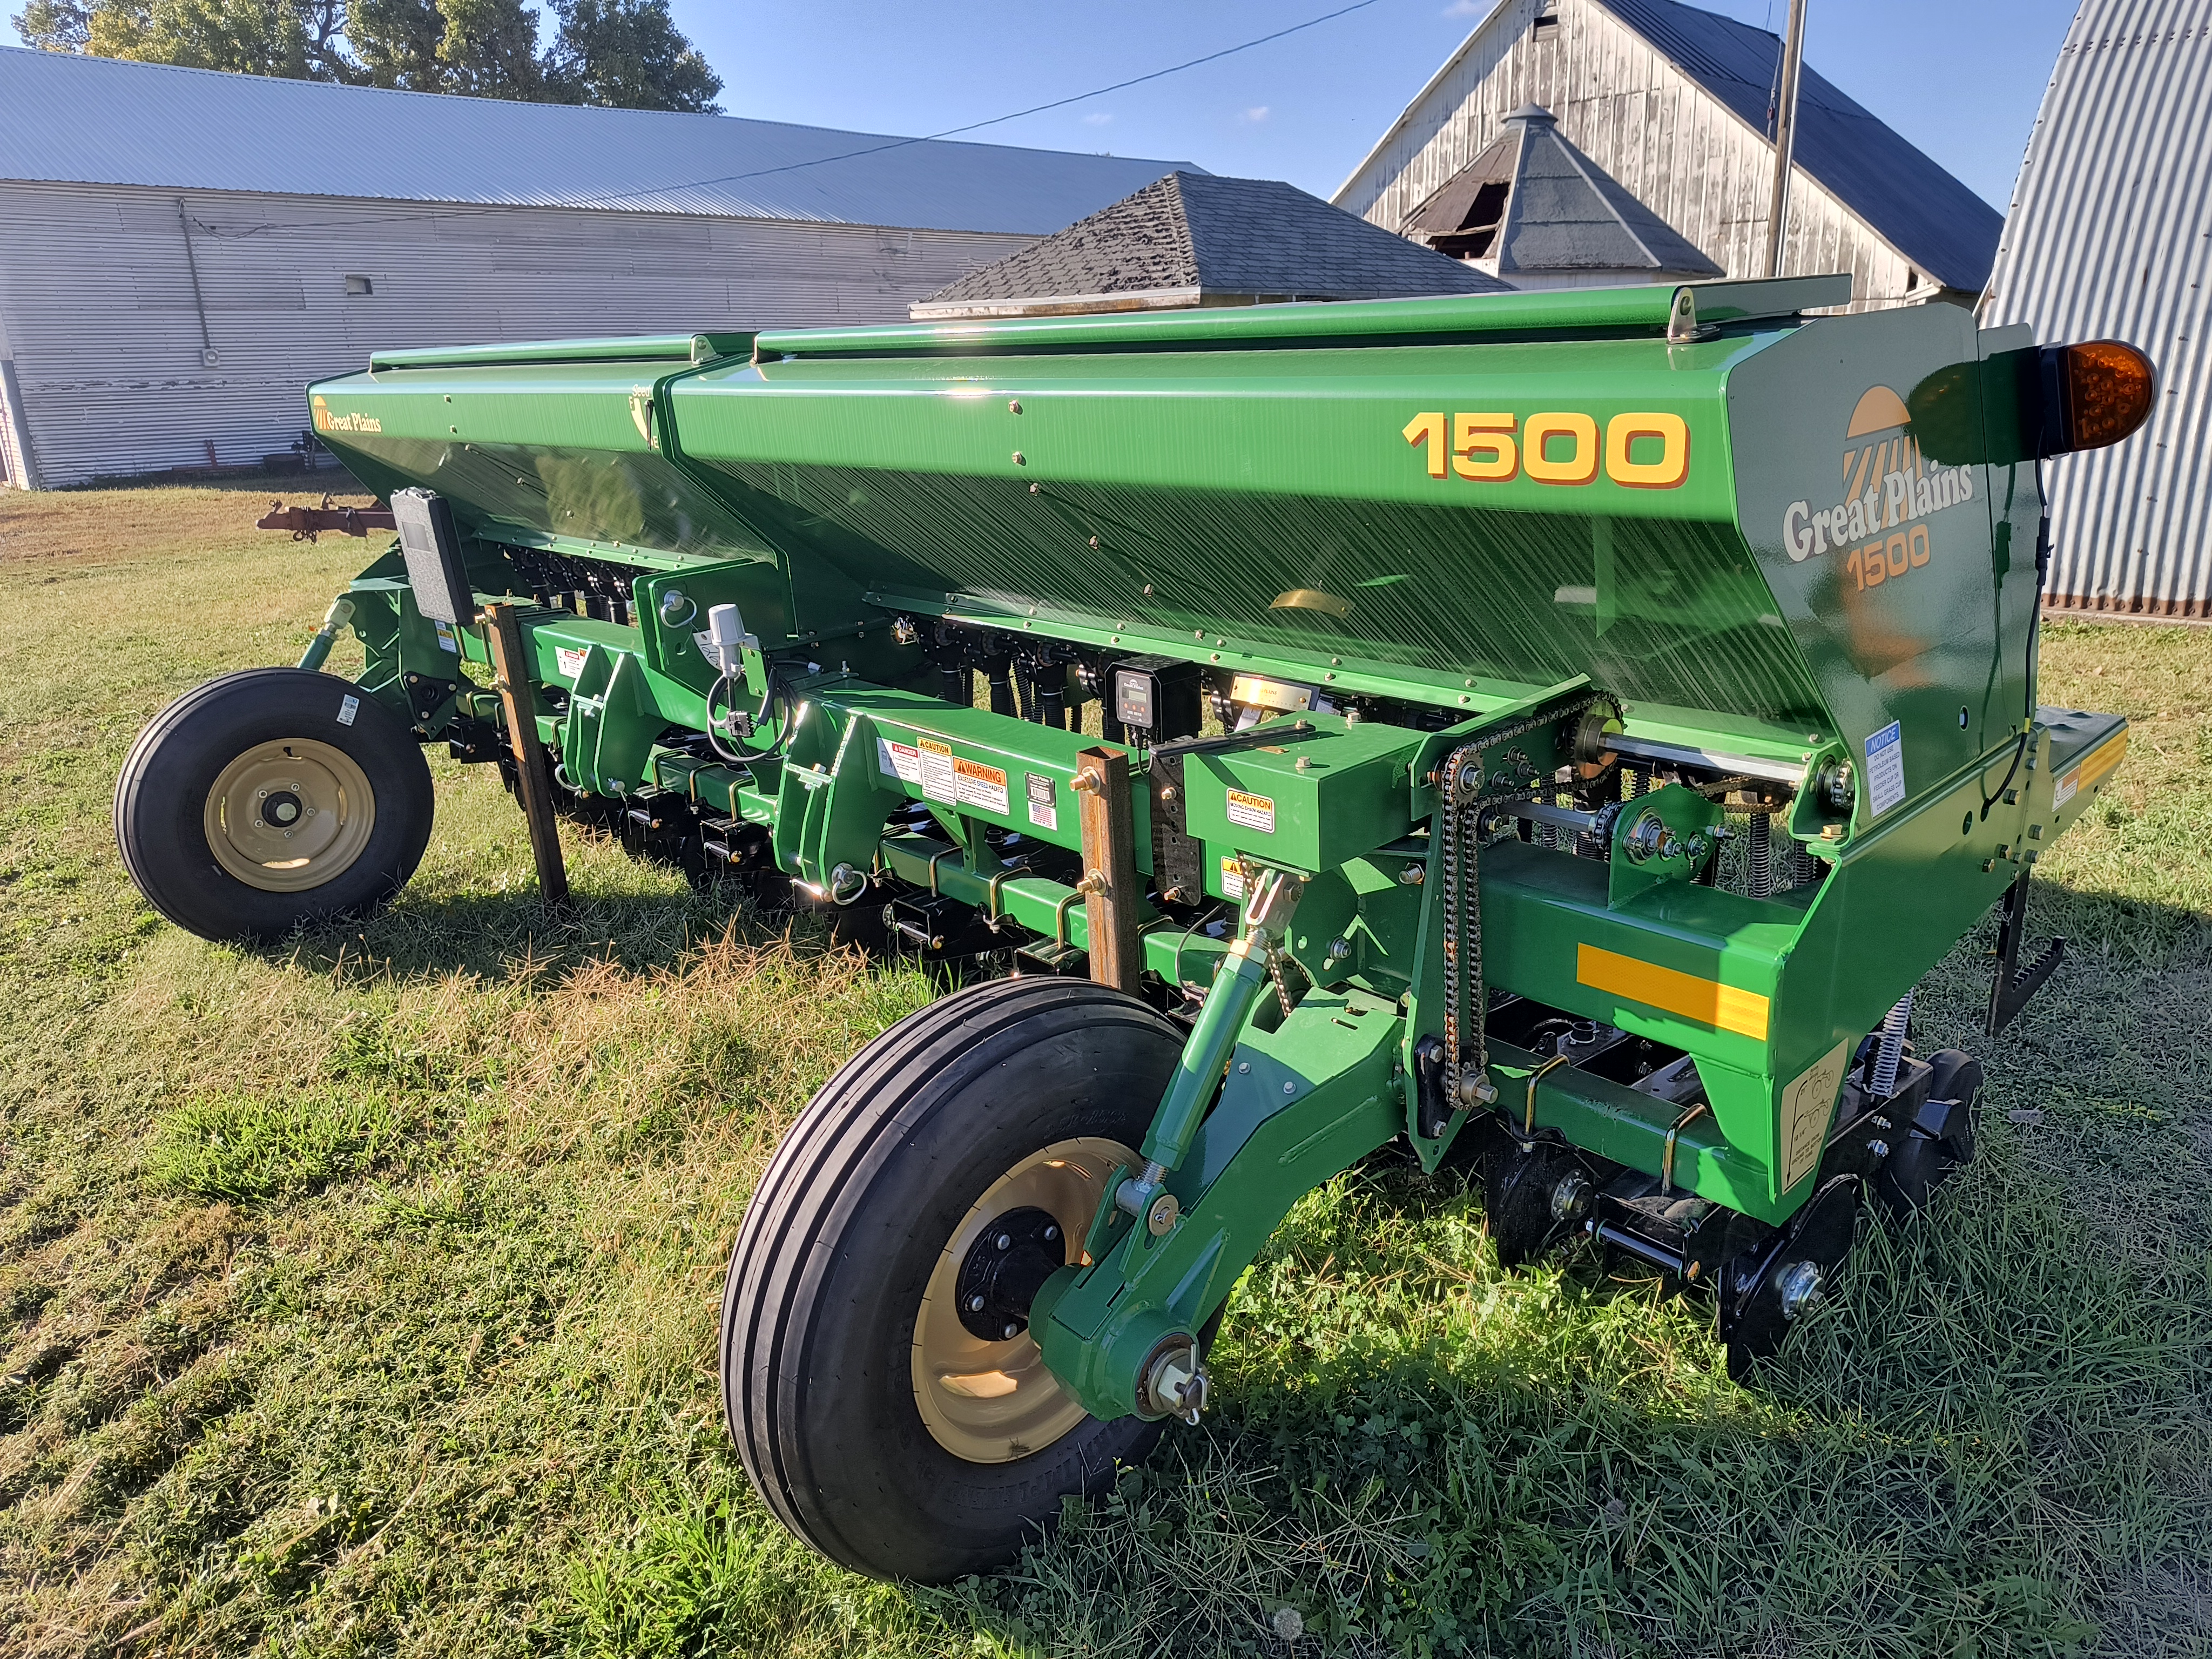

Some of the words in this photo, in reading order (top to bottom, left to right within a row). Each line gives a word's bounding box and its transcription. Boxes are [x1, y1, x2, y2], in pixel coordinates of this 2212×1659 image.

[632, 383, 651, 397] Seed
[326, 411, 353, 431] Great
[350, 412, 381, 433] Plains
[1402, 412, 1690, 489] 1500
[1783, 484, 1881, 562] Great
[1883, 459, 1972, 527] Plains
[1846, 523, 1930, 591] 1500
[925, 741, 949, 754] CAUTION
[1870, 726, 1897, 752] NOTICE
[898, 746, 916, 756] DANGER
[1874, 753, 1879, 761] DO
[1869, 758, 1889, 774] PETROLEUM
[1889, 751, 1899, 763] BASED
[1874, 766, 1891, 781] PRODUCTS
[1892, 763, 1897, 771] ON
[965, 763, 1002, 783] WARNING
[1873, 779, 1886, 792] FEEDER
[1894, 771, 1899, 779] OR
[977, 780, 988, 789] SPEED
[988, 784, 1003, 793] HAZARD
[1872, 791, 1883, 803] SMALL
[1884, 784, 1894, 796] GRASS
[1236, 794, 1270, 810] CAUTION
